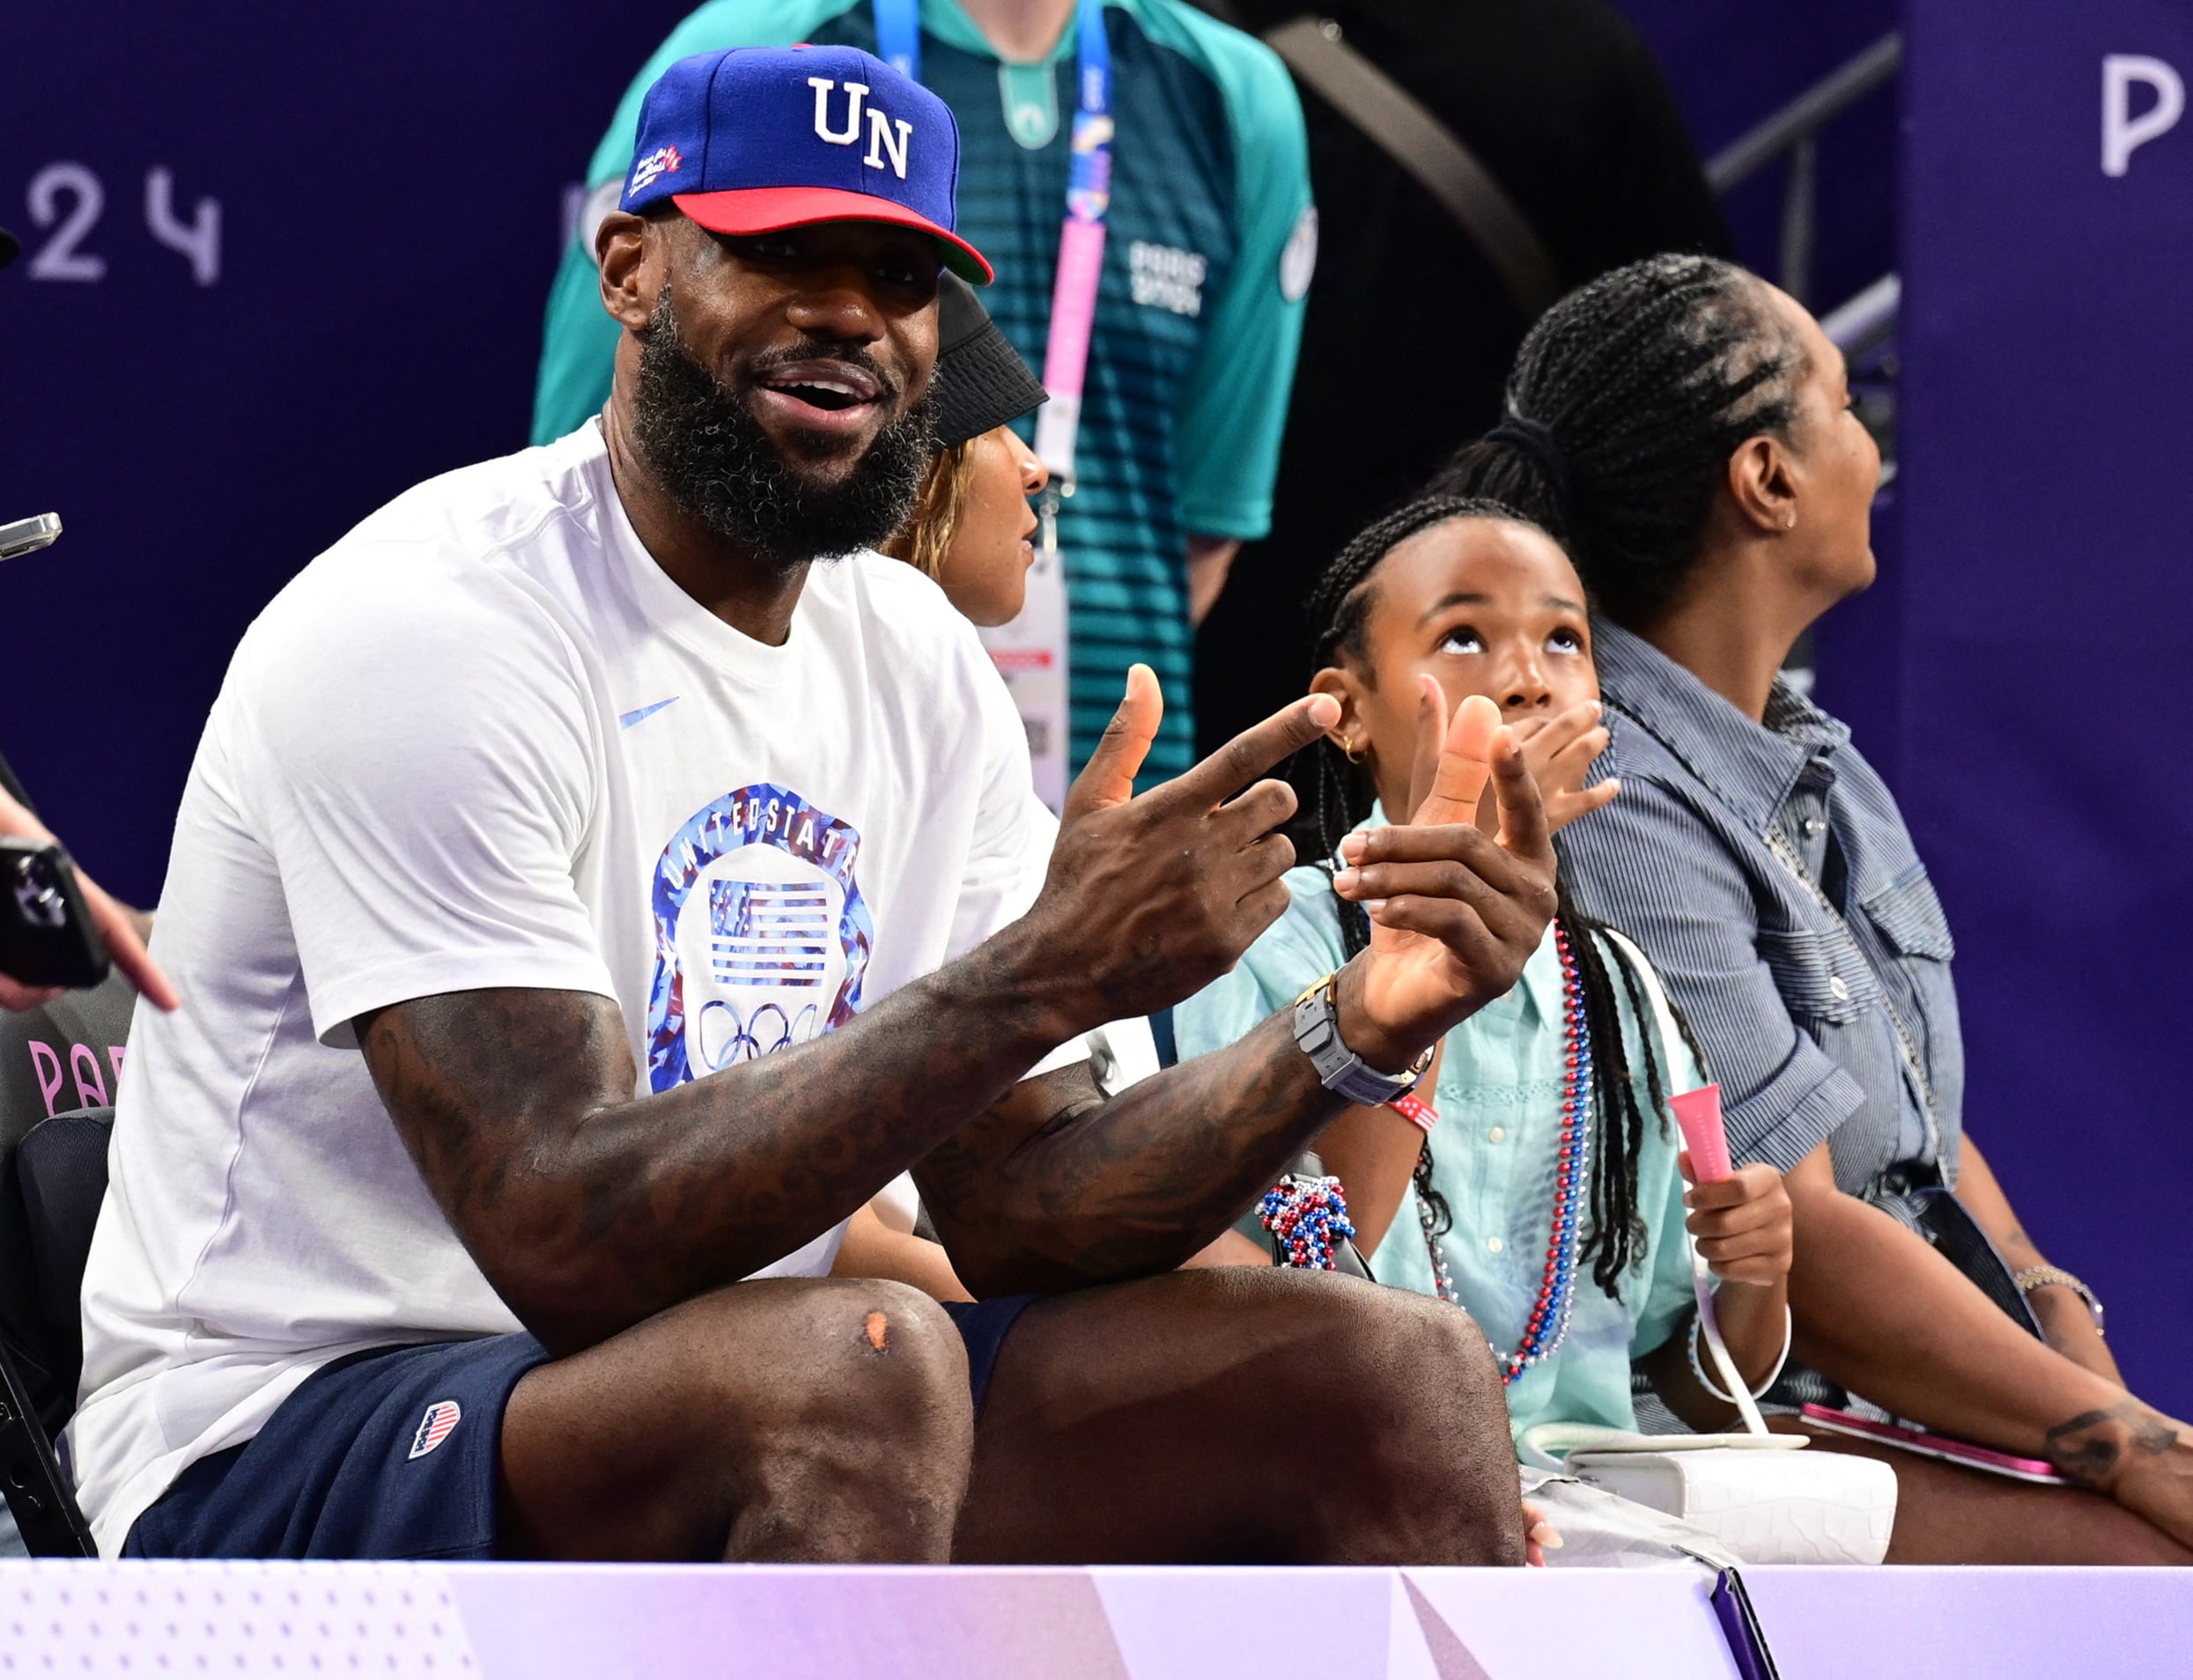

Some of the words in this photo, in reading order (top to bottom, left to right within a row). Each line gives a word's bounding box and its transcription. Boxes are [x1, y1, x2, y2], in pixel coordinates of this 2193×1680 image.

[808, 77, 912, 180] UN
[2101, 54, 2186, 177] P
[663, 798, 760, 890] UNITED
